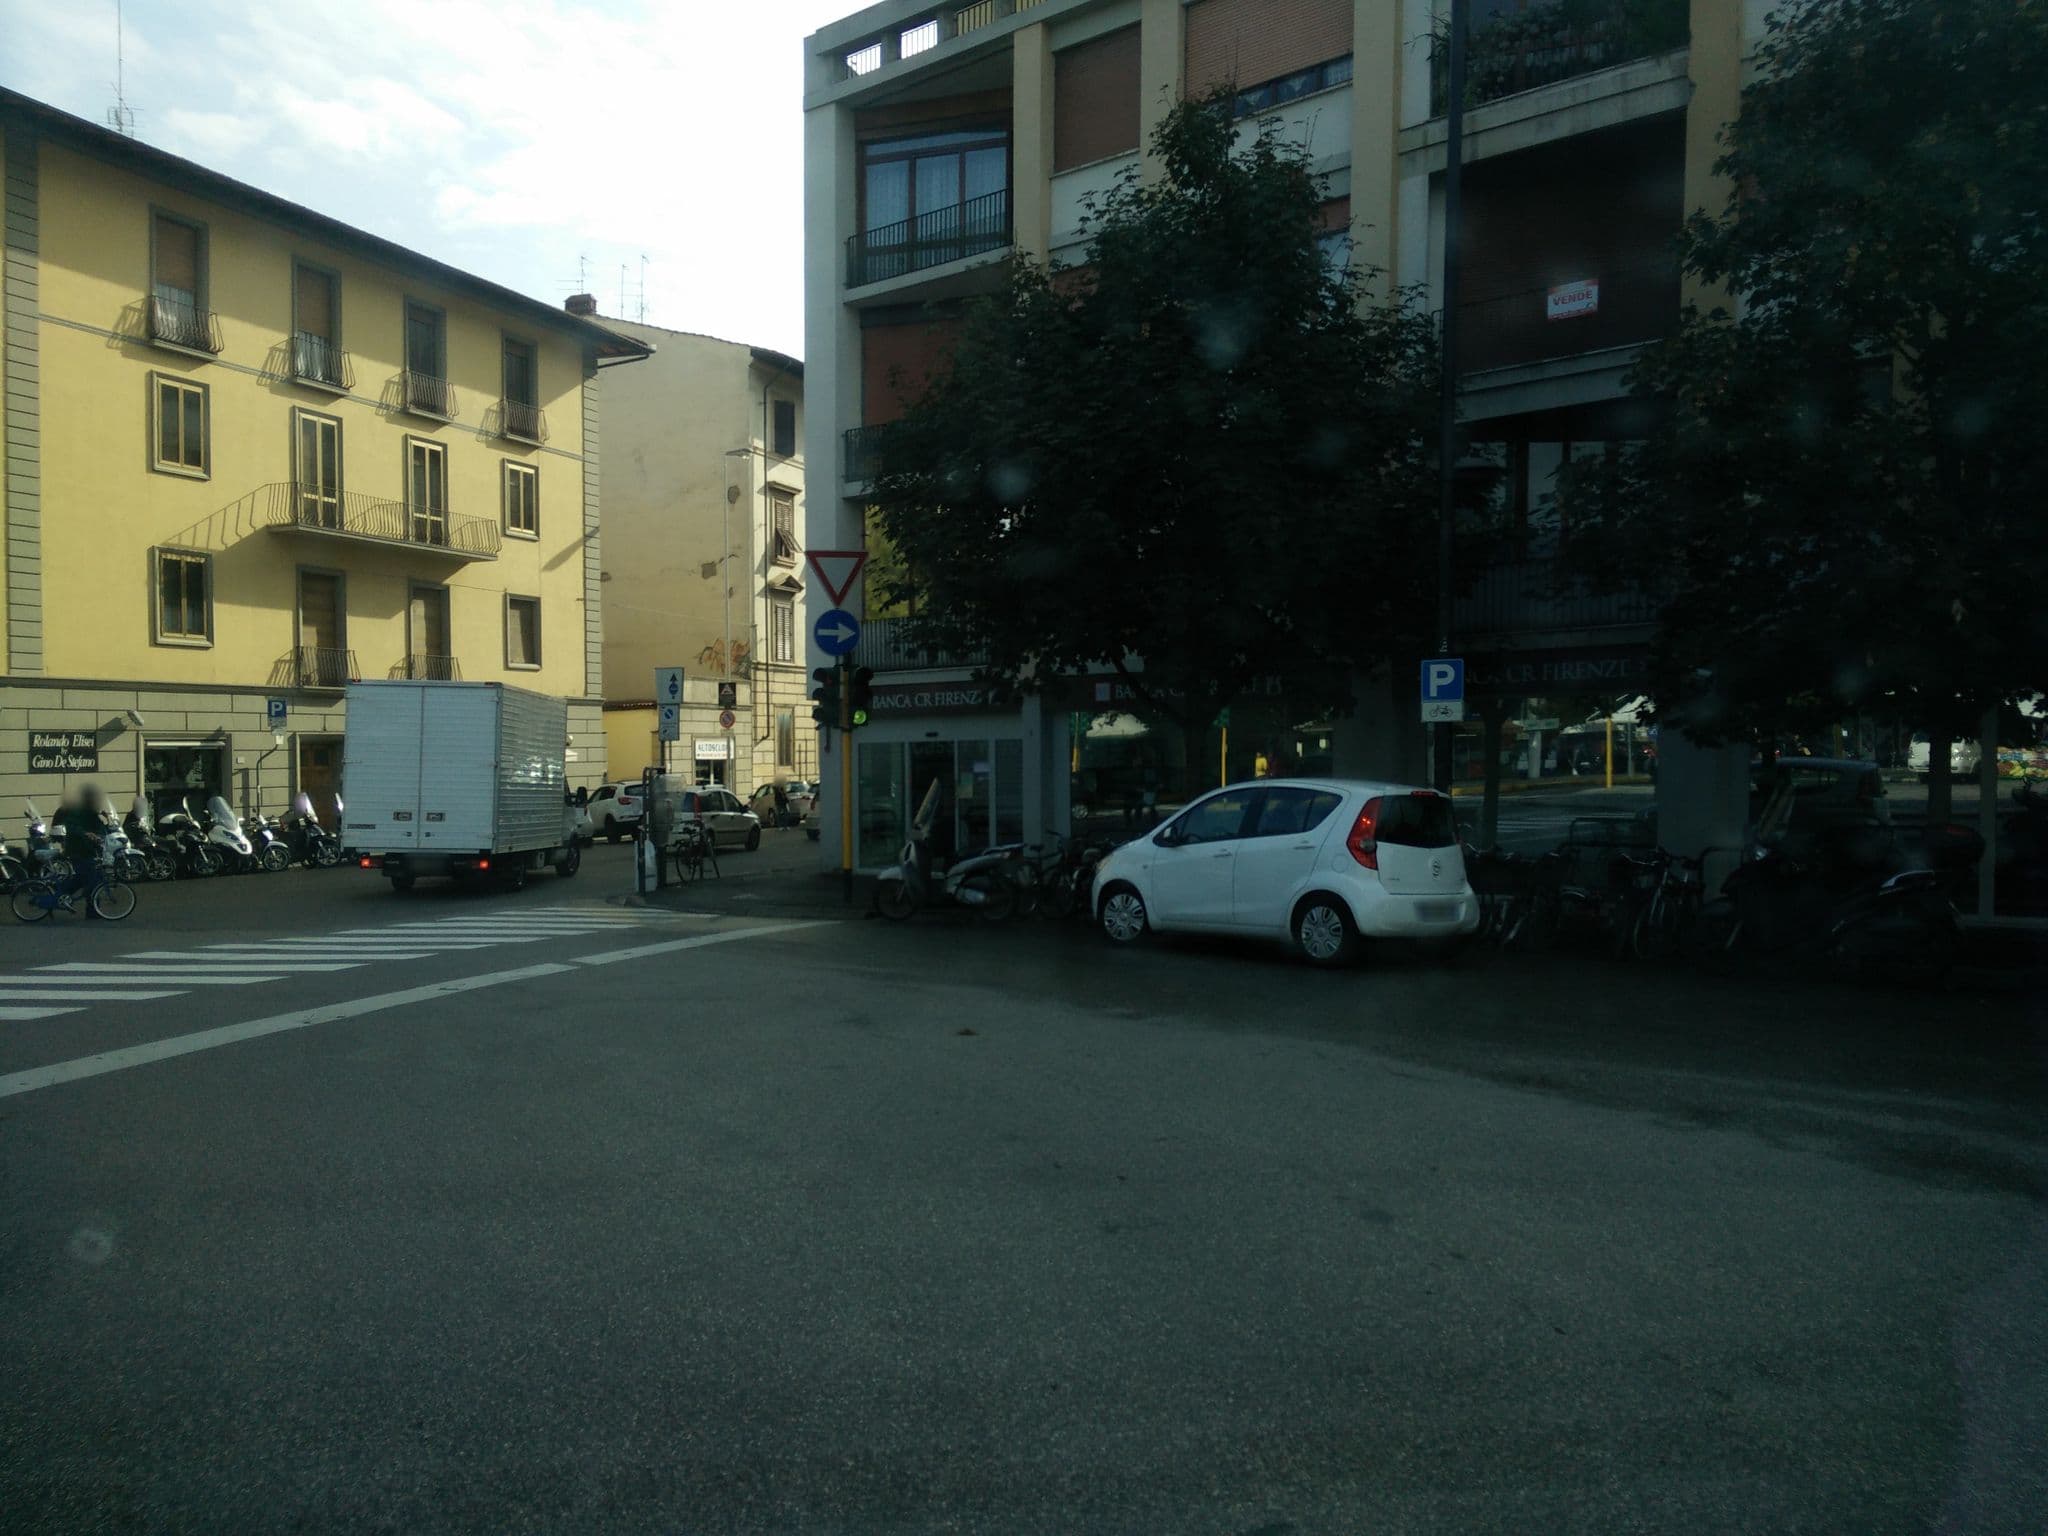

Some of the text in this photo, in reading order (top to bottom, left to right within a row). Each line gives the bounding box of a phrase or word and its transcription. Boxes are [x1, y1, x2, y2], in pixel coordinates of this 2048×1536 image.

[1552, 289, 1593, 305] VENDE
[1429, 664, 1456, 697] P
[872, 692, 913, 710] BANCA
[914, 691, 933, 706] CR
[271, 701, 284, 717] P
[33, 733, 70, 748] Rolando
[32, 755, 96, 771] Gino De Stefano
